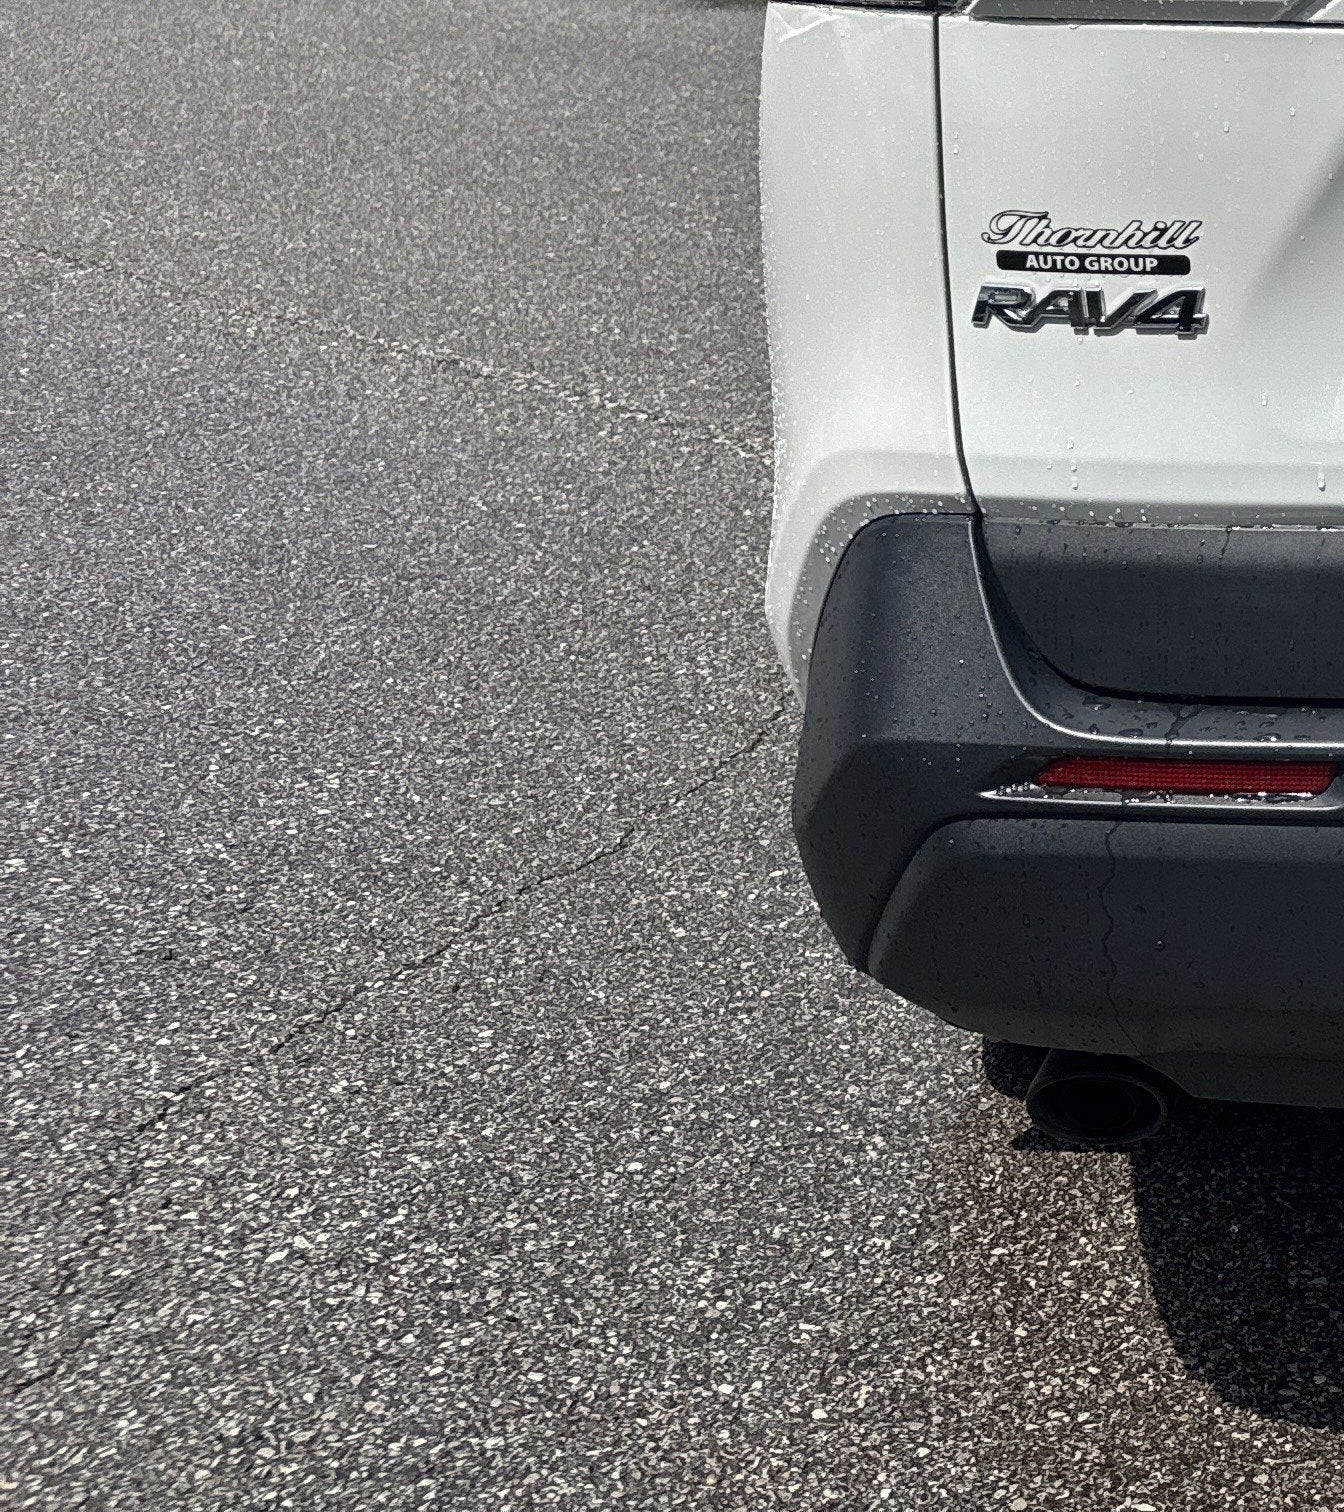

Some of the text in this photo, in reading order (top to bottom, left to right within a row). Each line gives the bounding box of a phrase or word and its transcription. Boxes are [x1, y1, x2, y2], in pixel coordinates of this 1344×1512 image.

[981, 209, 1203, 250] Thornhill
[1025, 254, 1159, 272] AUTO GROUP
[971, 282, 1209, 340] RAV4
